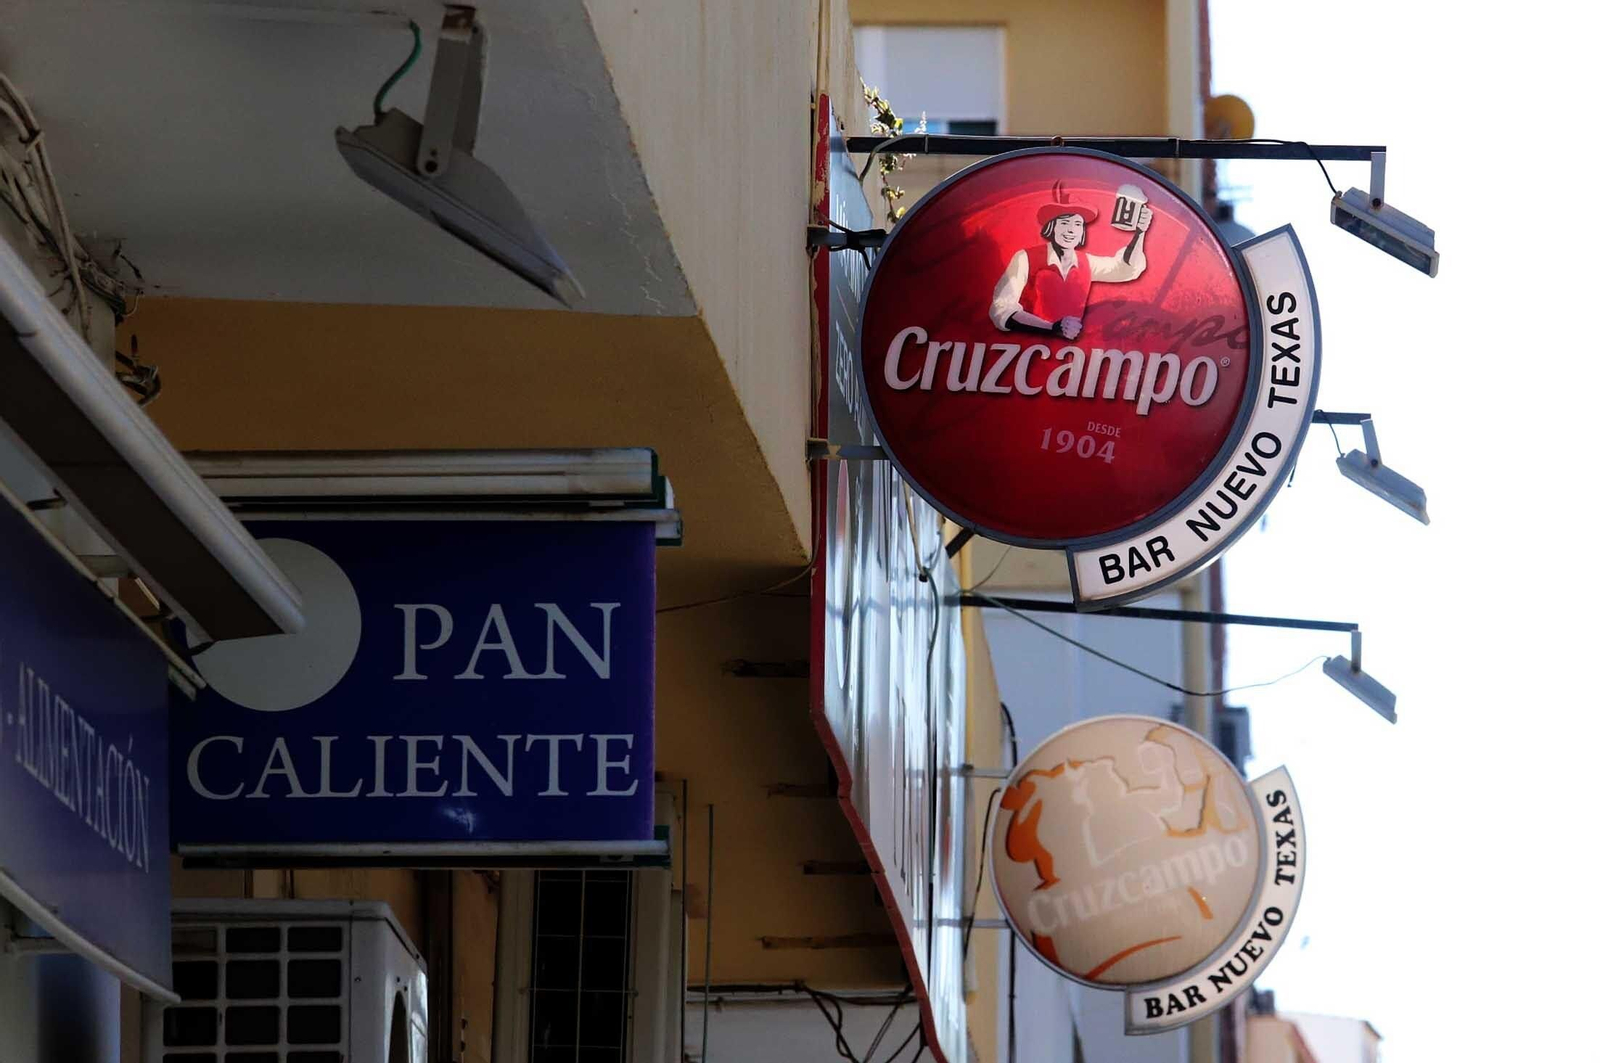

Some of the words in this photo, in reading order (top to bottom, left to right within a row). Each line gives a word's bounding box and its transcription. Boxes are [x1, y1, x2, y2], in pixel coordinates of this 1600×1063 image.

[884, 326, 1218, 416] Cruzcampo
[1040, 426, 1116, 464] 1904
[1087, 421, 1121, 439] DESDE
[1098, 535, 1175, 585] BAR
[1186, 431, 1282, 542] NUEVO
[1266, 291, 1301, 406] TEXAS
[392, 602, 621, 681] PAN
[15, 661, 151, 874] ALIMENTACIÓN
[186, 733, 639, 801] CALIENTE
[1027, 835, 1249, 934] Cruzcampo
[1144, 985, 1207, 1019] BAR
[1207, 906, 1284, 994] NUEVO
[1266, 789, 1297, 887] TEXAS
